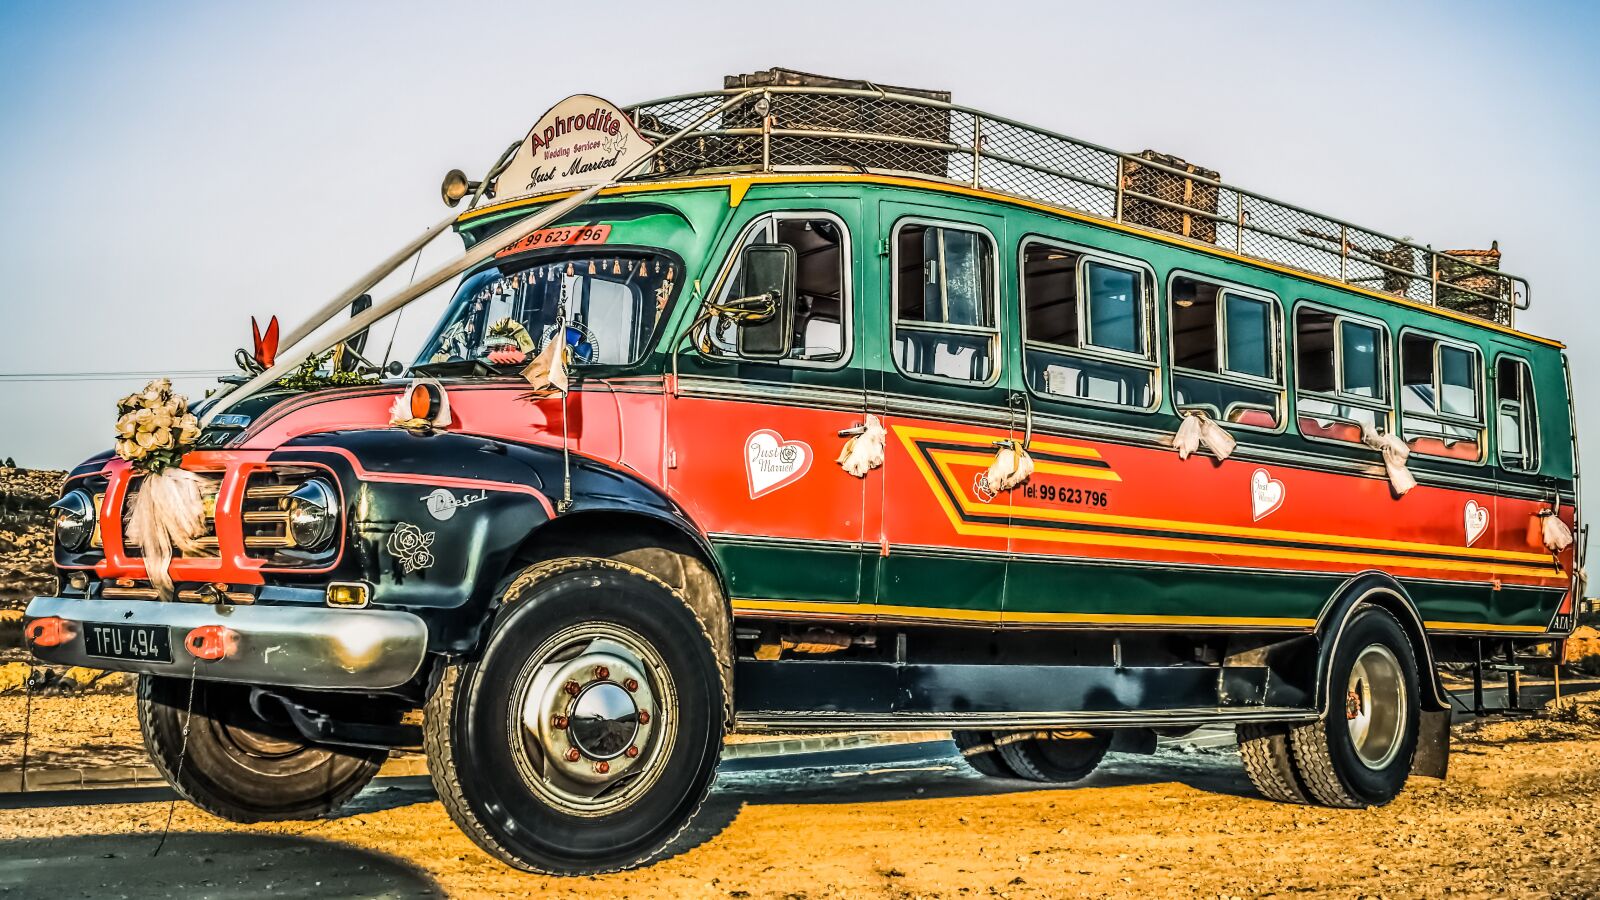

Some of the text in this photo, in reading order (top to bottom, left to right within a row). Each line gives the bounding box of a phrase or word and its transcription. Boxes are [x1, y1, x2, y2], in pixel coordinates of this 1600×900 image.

[531, 108, 621, 157] Aphrodite
[544, 140, 601, 160] Wedding Services
[525, 150, 621, 190] Just Married
[525, 233, 543, 247] 99
[544, 230, 571, 244] 623
[573, 228, 603, 242] 796
[750, 442, 779, 463] Just
[758, 458, 795, 473] Married
[419, 489, 489, 514] Diesel
[1023, 482, 1108, 507] Tel: 99 623 796
[93, 627, 159, 657] TFU 494
